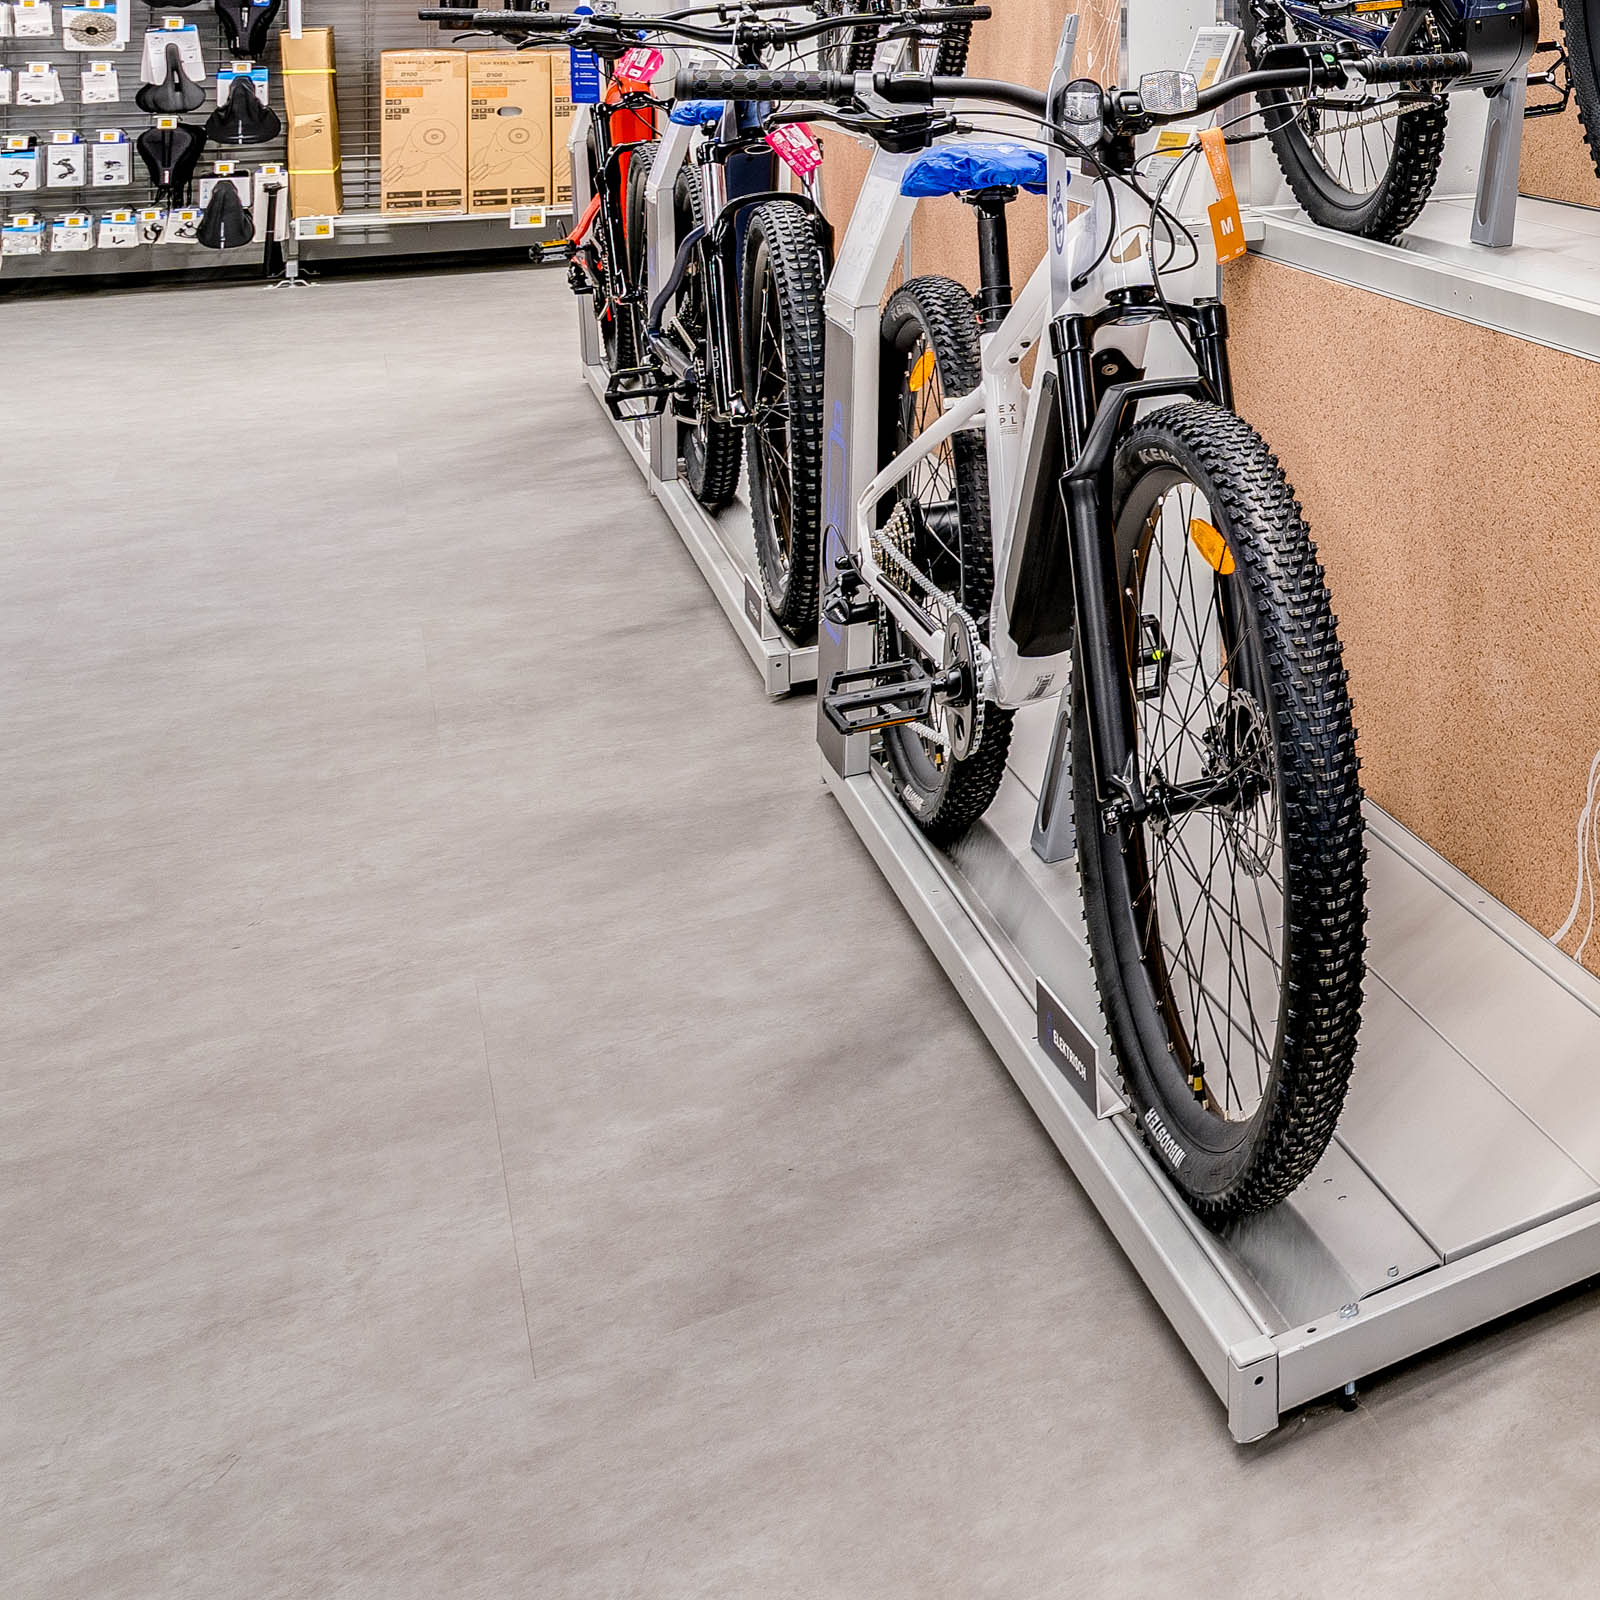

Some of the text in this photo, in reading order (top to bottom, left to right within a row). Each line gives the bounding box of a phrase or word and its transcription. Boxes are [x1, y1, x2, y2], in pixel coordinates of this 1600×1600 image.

[1220, 216, 1234, 237] M
[1053, 1029, 1086, 1081] ELEKTRISCH
[1144, 1106, 1180, 1161] BOOSTER
